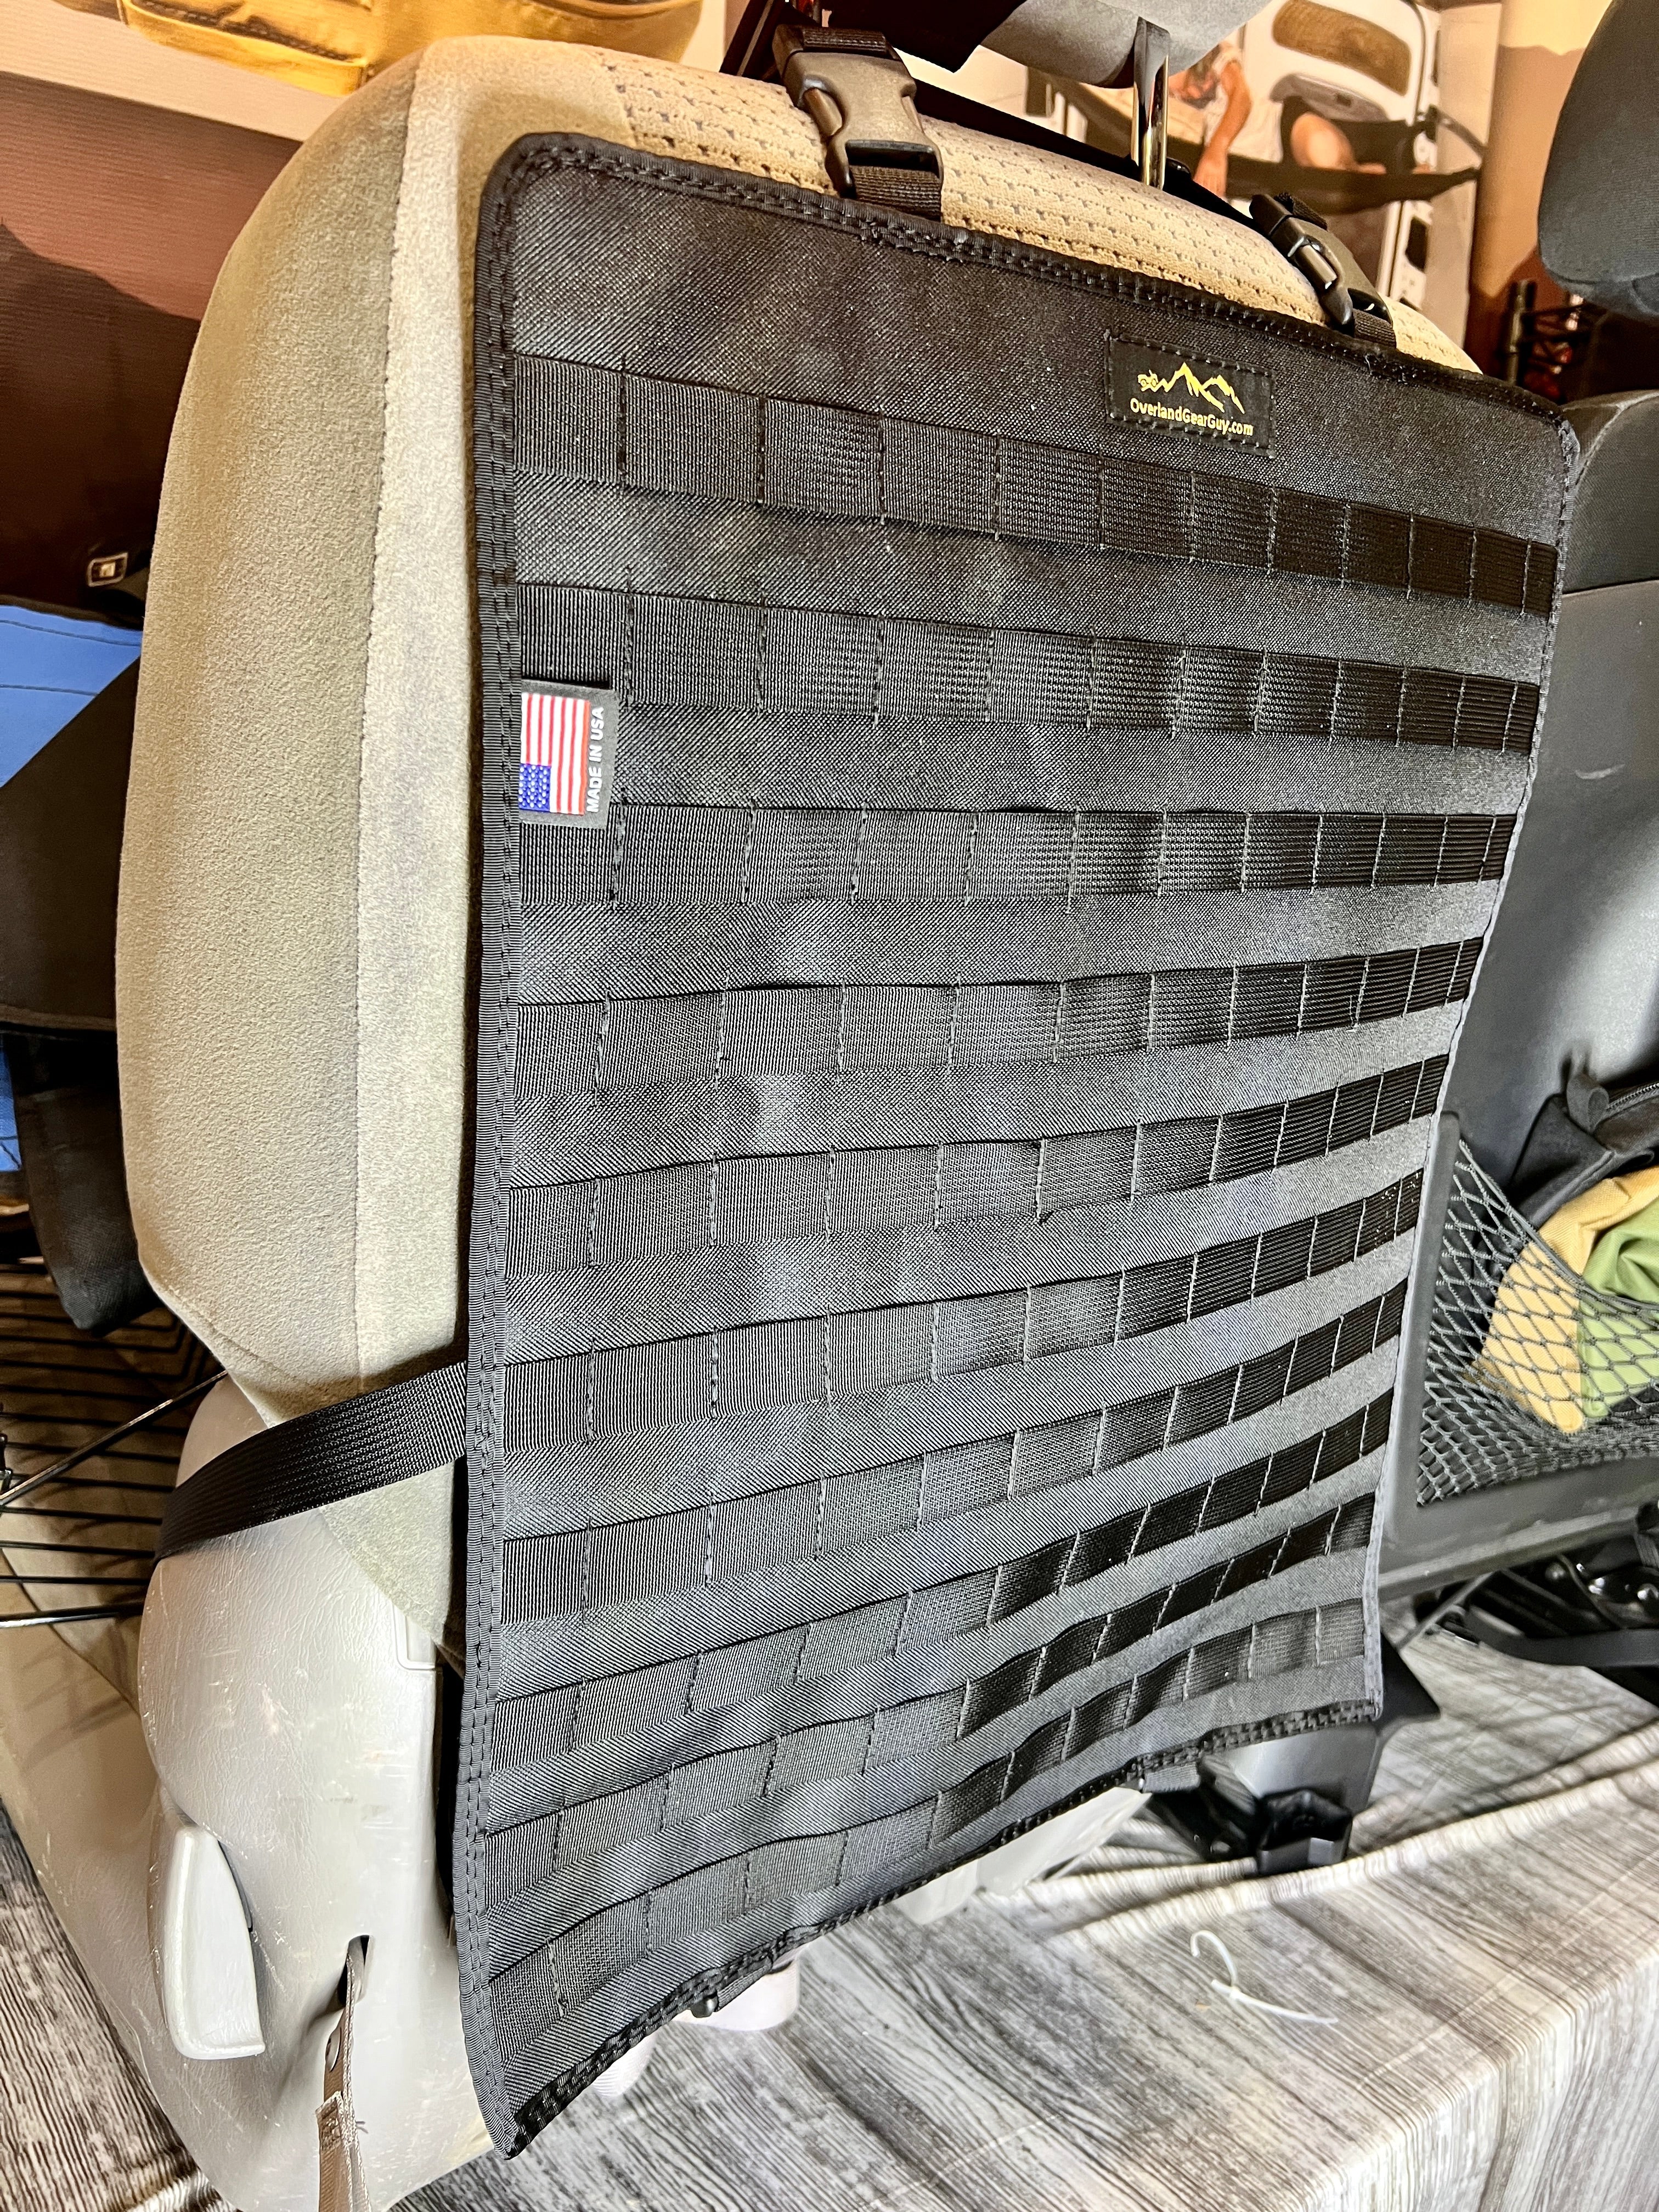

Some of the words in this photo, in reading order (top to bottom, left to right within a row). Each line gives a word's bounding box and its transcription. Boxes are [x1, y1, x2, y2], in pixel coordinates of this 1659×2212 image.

[1130, 398, 1254, 436] OverlandGearGuy.com
[590, 707, 604, 741] USA
[589, 744, 602, 762] IN
[586, 767, 602, 812] MADE
